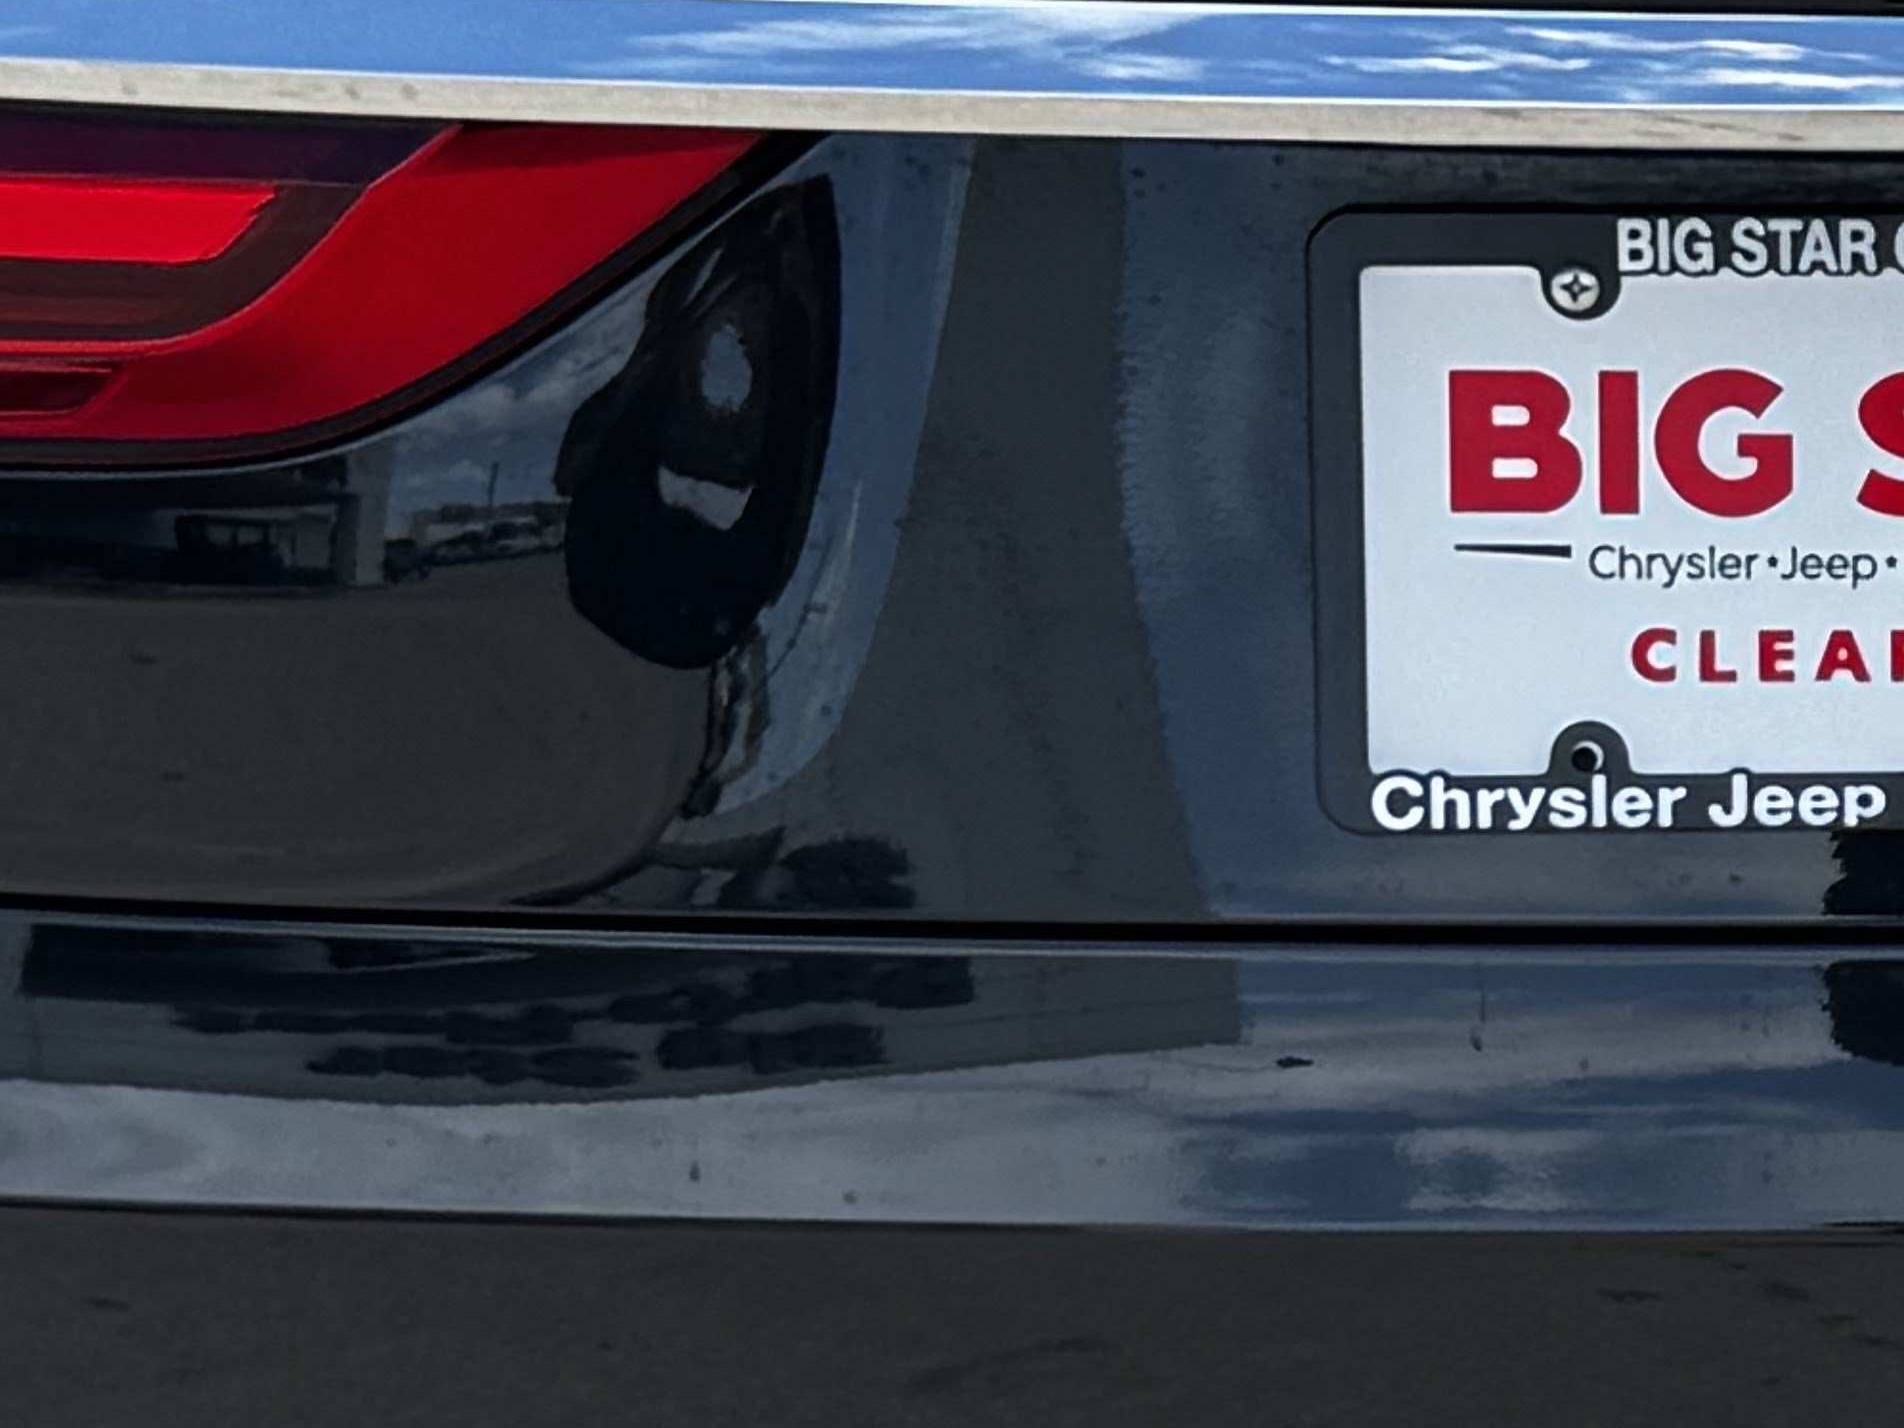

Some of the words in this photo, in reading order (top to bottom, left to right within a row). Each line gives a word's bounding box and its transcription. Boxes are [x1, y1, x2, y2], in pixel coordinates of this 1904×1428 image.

[1615, 216, 1716, 274] BIG
[1730, 216, 1879, 274] STAR
[1447, 368, 1794, 518] BIG
[1587, 544, 1760, 590] Chrysler
[1780, 544, 1879, 591] Jeep
[1370, 773, 1688, 832] Chrysler
[1707, 772, 1887, 830] Jeep
